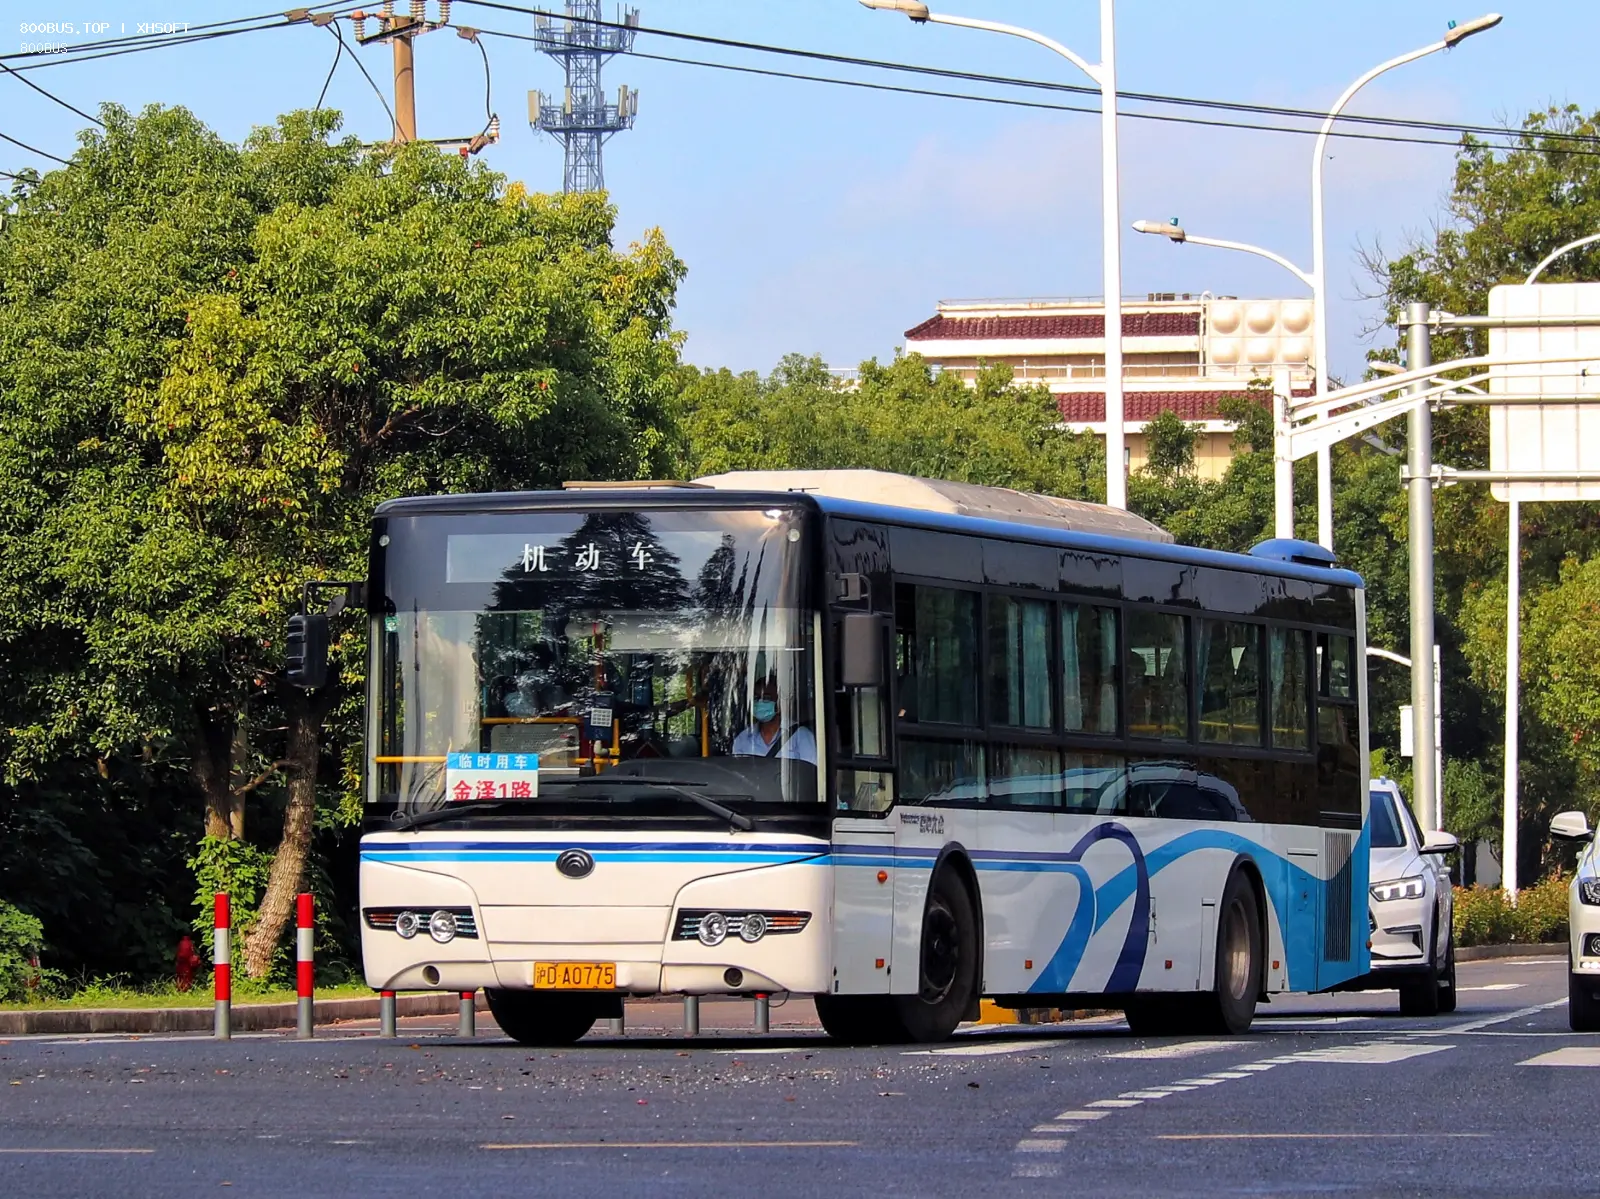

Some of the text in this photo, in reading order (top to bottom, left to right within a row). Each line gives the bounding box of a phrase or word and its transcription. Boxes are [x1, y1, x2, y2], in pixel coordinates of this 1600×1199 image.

[520, 541, 655, 573] 机动车
[458, 754, 528, 769] 临时用车
[452, 780, 532, 800] 金泽1路
